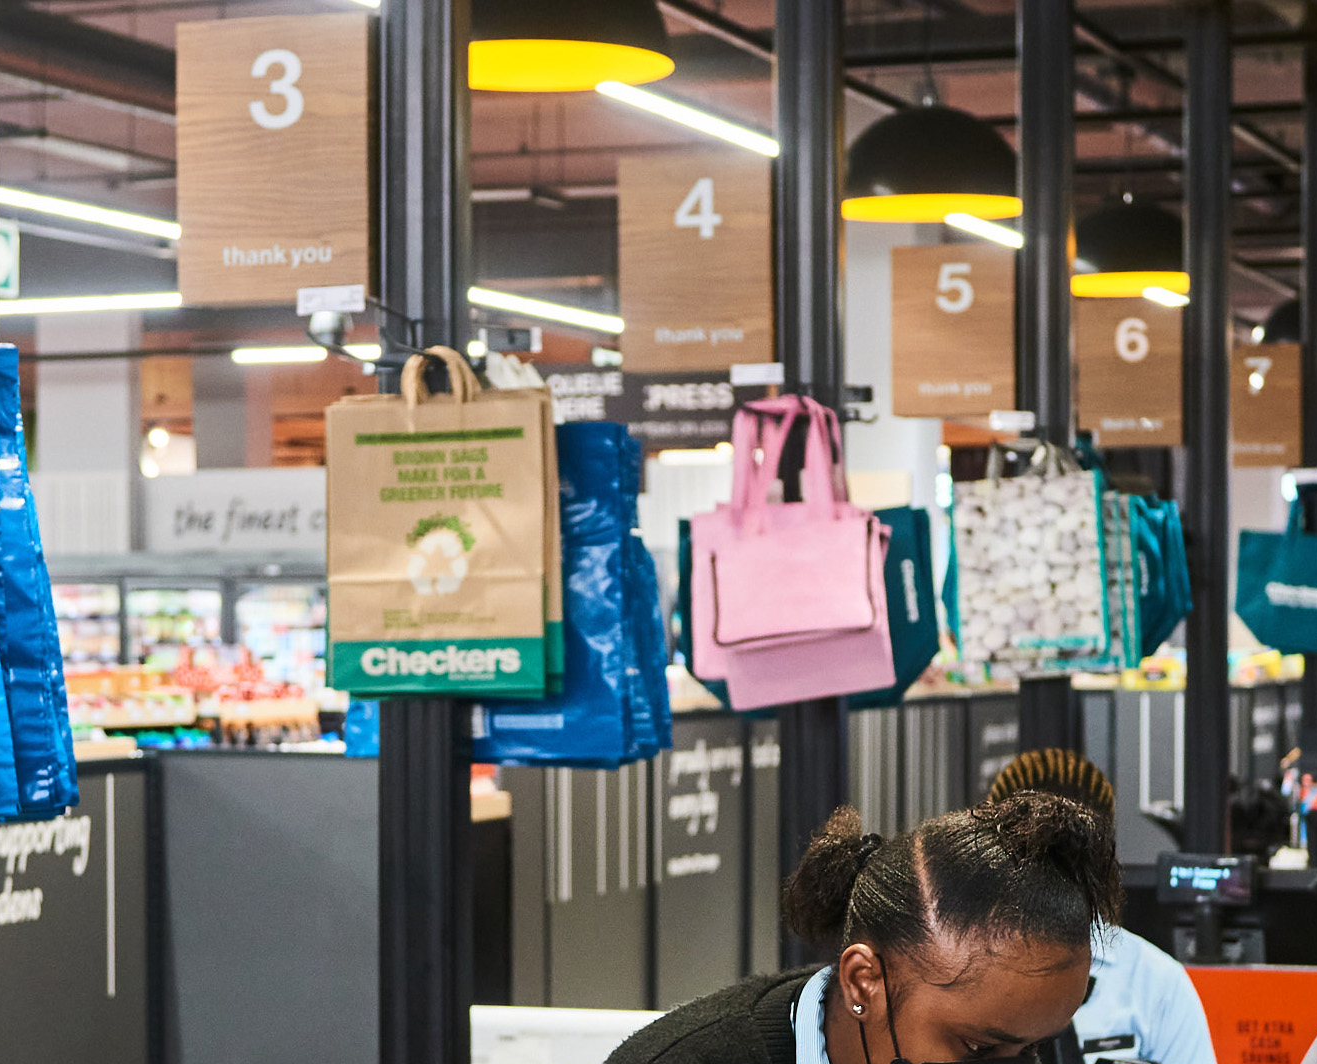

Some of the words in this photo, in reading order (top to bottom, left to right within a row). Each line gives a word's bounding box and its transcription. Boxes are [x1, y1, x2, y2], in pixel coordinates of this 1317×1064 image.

[248, 48, 305, 130] 3
[673, 178, 722, 240] 4
[223, 242, 288, 268] thank
[291, 245, 333, 271] you
[935, 262, 974, 314] 5
[1114, 317, 1150, 363] 6
[1244, 357, 1273, 394] 7
[174, 501, 215, 537] the
[222, 498, 300, 543] finest
[361, 645, 521, 676] Checkers
